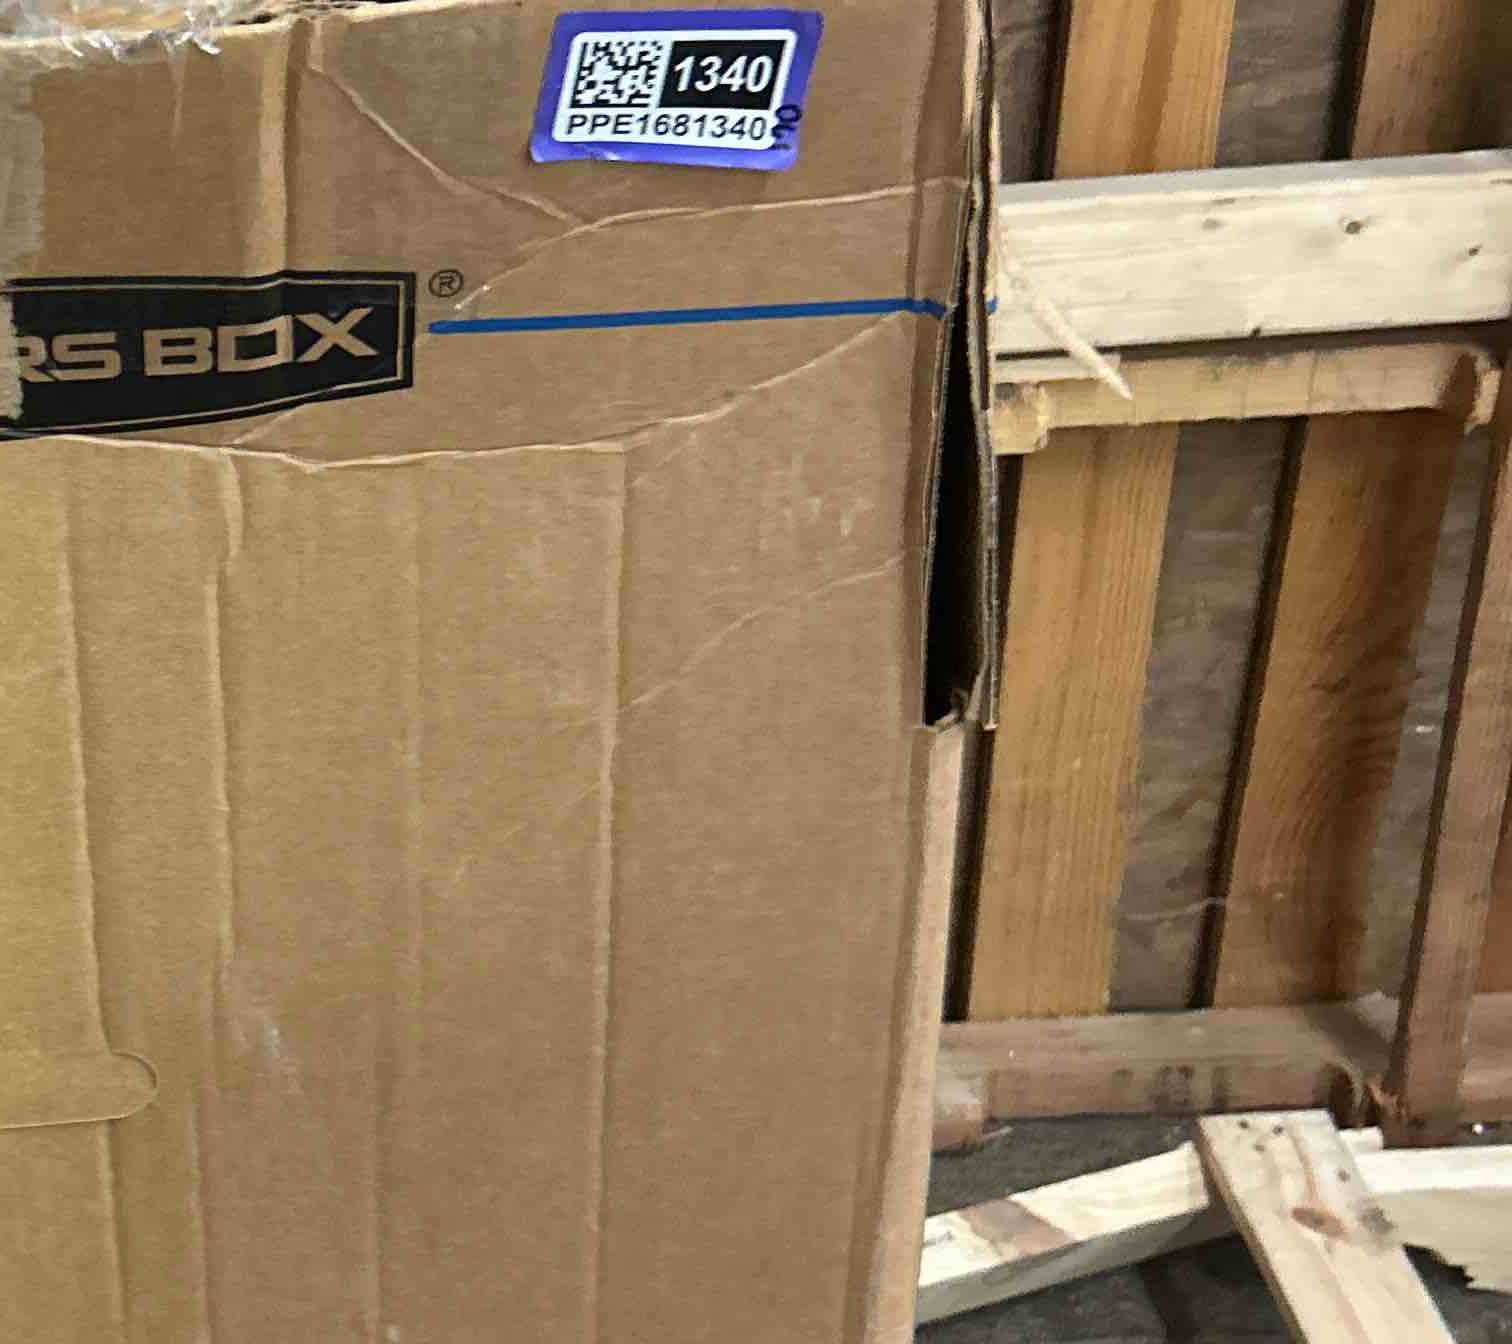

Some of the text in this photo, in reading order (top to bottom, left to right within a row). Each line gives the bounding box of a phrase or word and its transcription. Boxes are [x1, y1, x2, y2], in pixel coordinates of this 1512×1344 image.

[674, 54, 775, 94] 1340
[566, 112, 768, 142] PPE1681340
[142, 306, 379, 378] BOX
